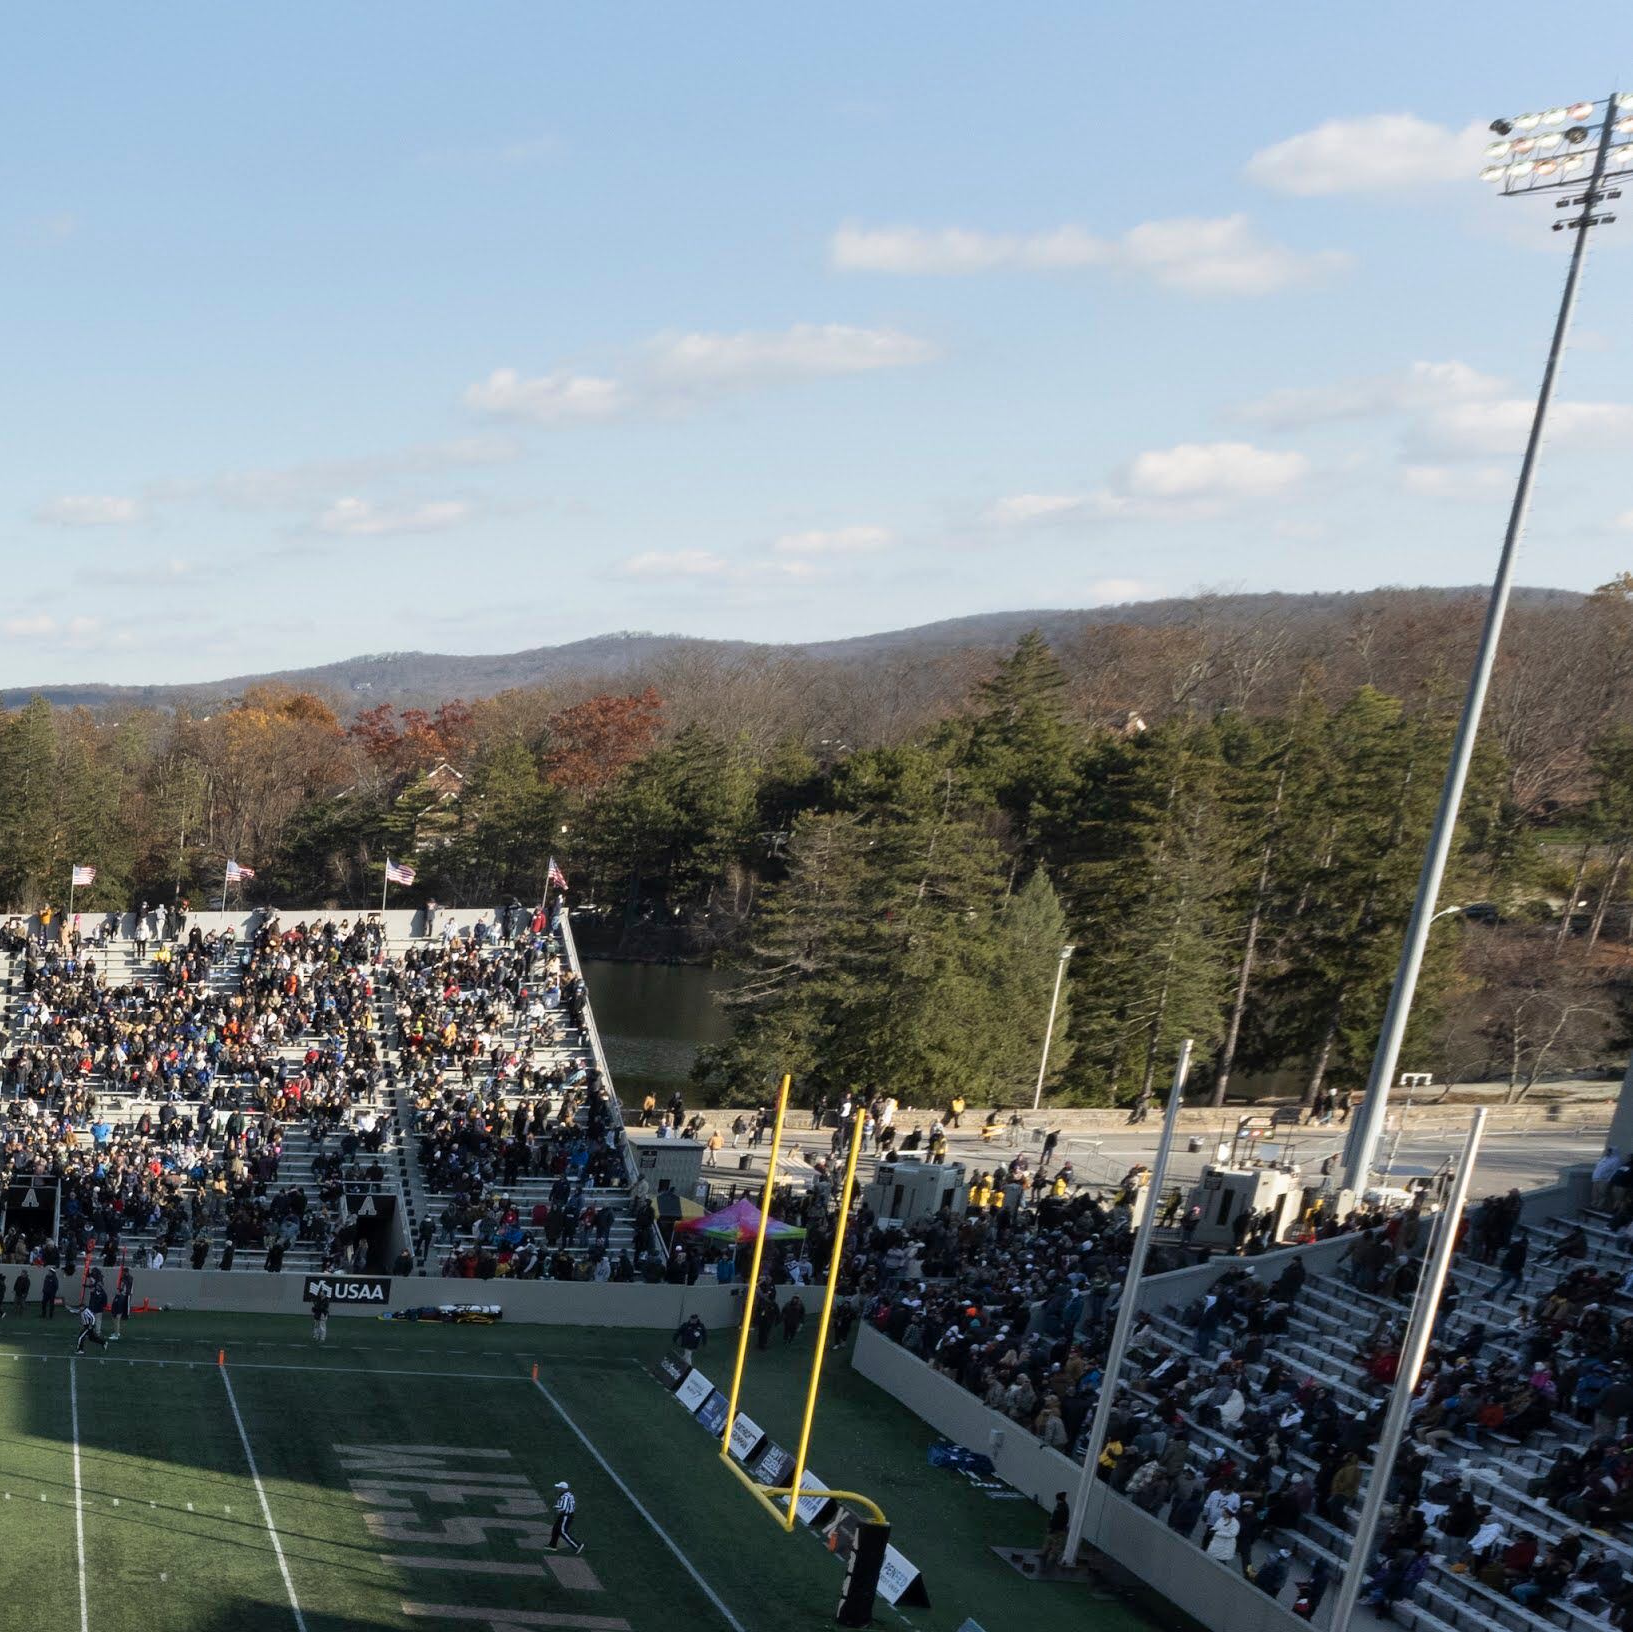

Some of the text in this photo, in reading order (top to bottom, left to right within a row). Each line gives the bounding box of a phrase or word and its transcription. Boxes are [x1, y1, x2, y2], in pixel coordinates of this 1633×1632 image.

[359, 1195, 377, 1216] A
[336, 1282, 384, 1300] USAA
[333, 1443, 607, 1591] WEST
